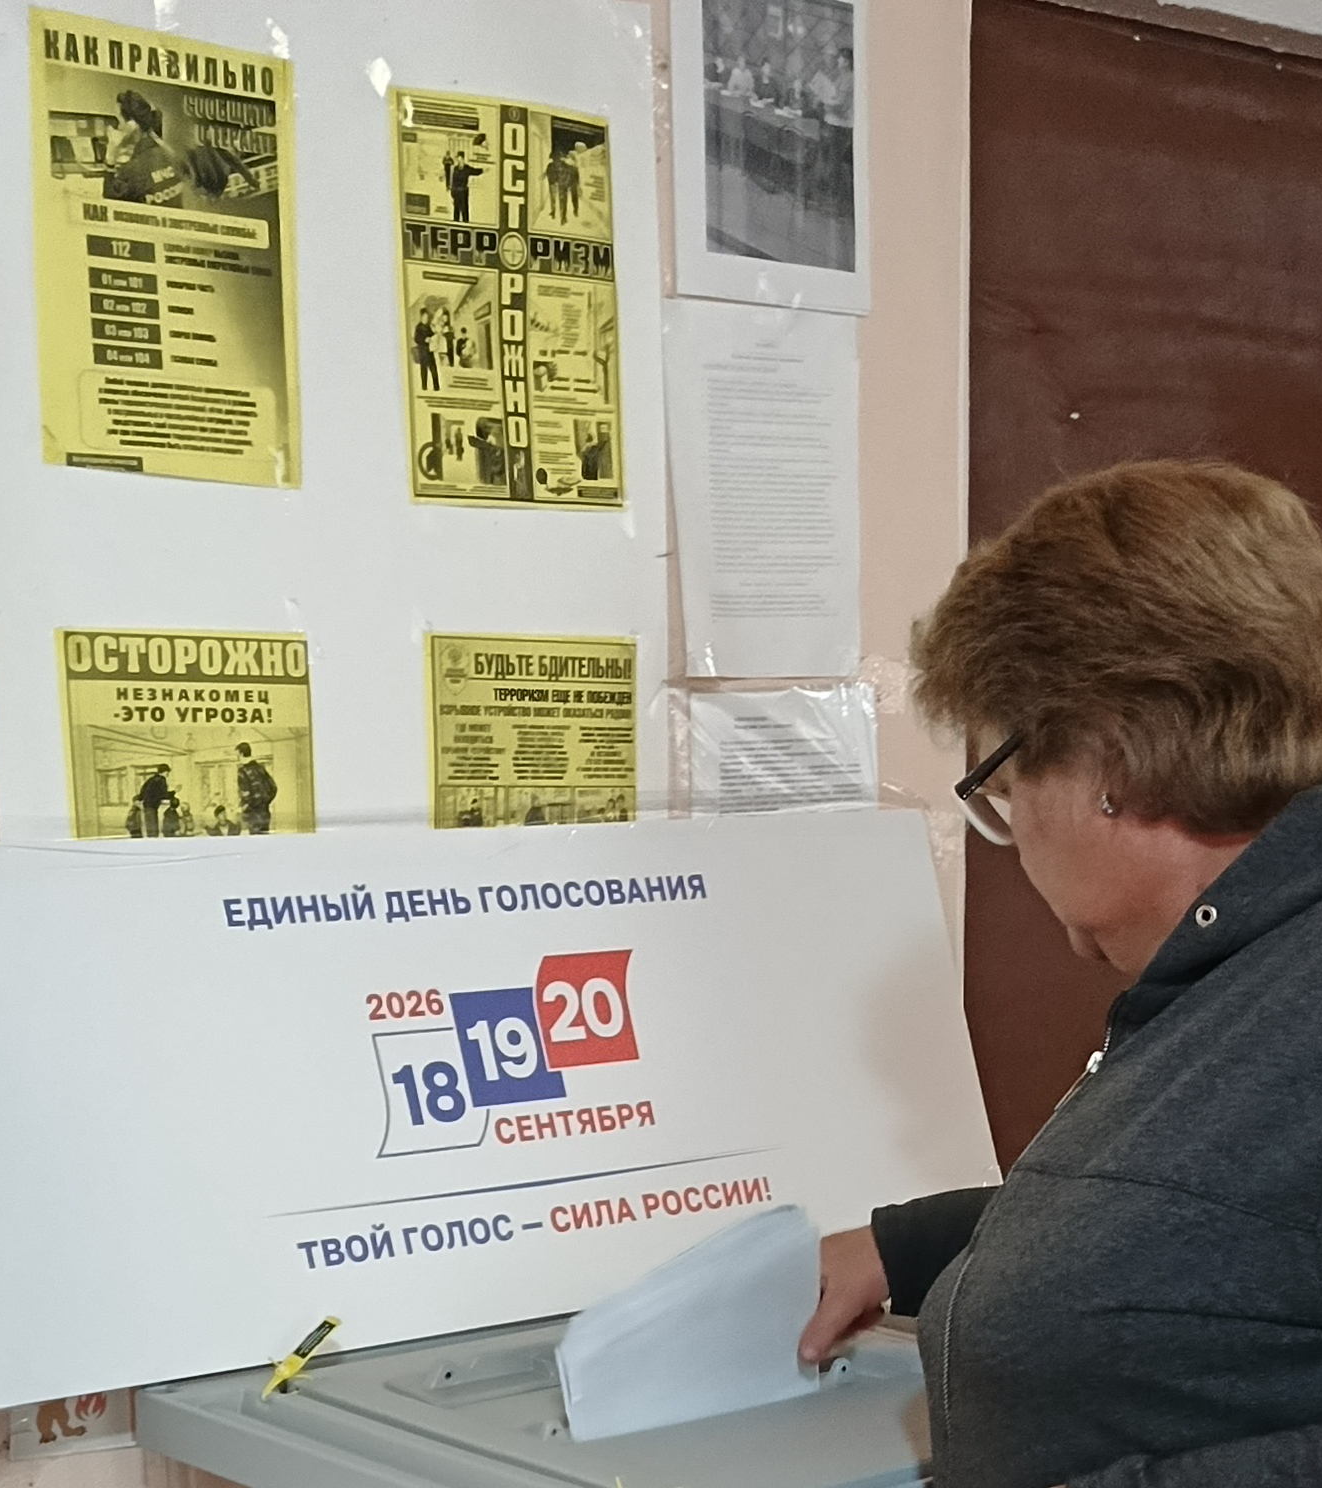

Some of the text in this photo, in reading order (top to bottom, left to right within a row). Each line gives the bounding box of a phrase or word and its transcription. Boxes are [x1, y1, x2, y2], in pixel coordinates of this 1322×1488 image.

[44, 29, 274, 95] КАК ПРАВИЛЬНО
[111, 240, 131, 258] 112
[67, 634, 306, 678] ОСТОРОЖНО
[474, 653, 632, 682] БУДЬТЕ БДИТЕЛЬНЫ!
[116, 687, 270, 705] НЕЗНАКОМЕЦ
[493, 688, 549, 702] ТЕРРОРИЗМ
[175, 707, 273, 724] УГРОЗА!
[223, 873, 707, 931] ЕДИНЫЙ ДЕНЬ ГОЛОСОВАНИЯ
[366, 988, 444, 1021] 2026
[392, 976, 624, 1126] 18 19 20
[494, 1100, 656, 1145] СЕНТЯБРЯ
[297, 1223, 395, 1270] ТВОЙ
[401, 1213, 514, 1256] ГОЛОС
[549, 1200, 637, 1234] СИЛА
[642, 1176, 773, 1219] РОССИИ!
